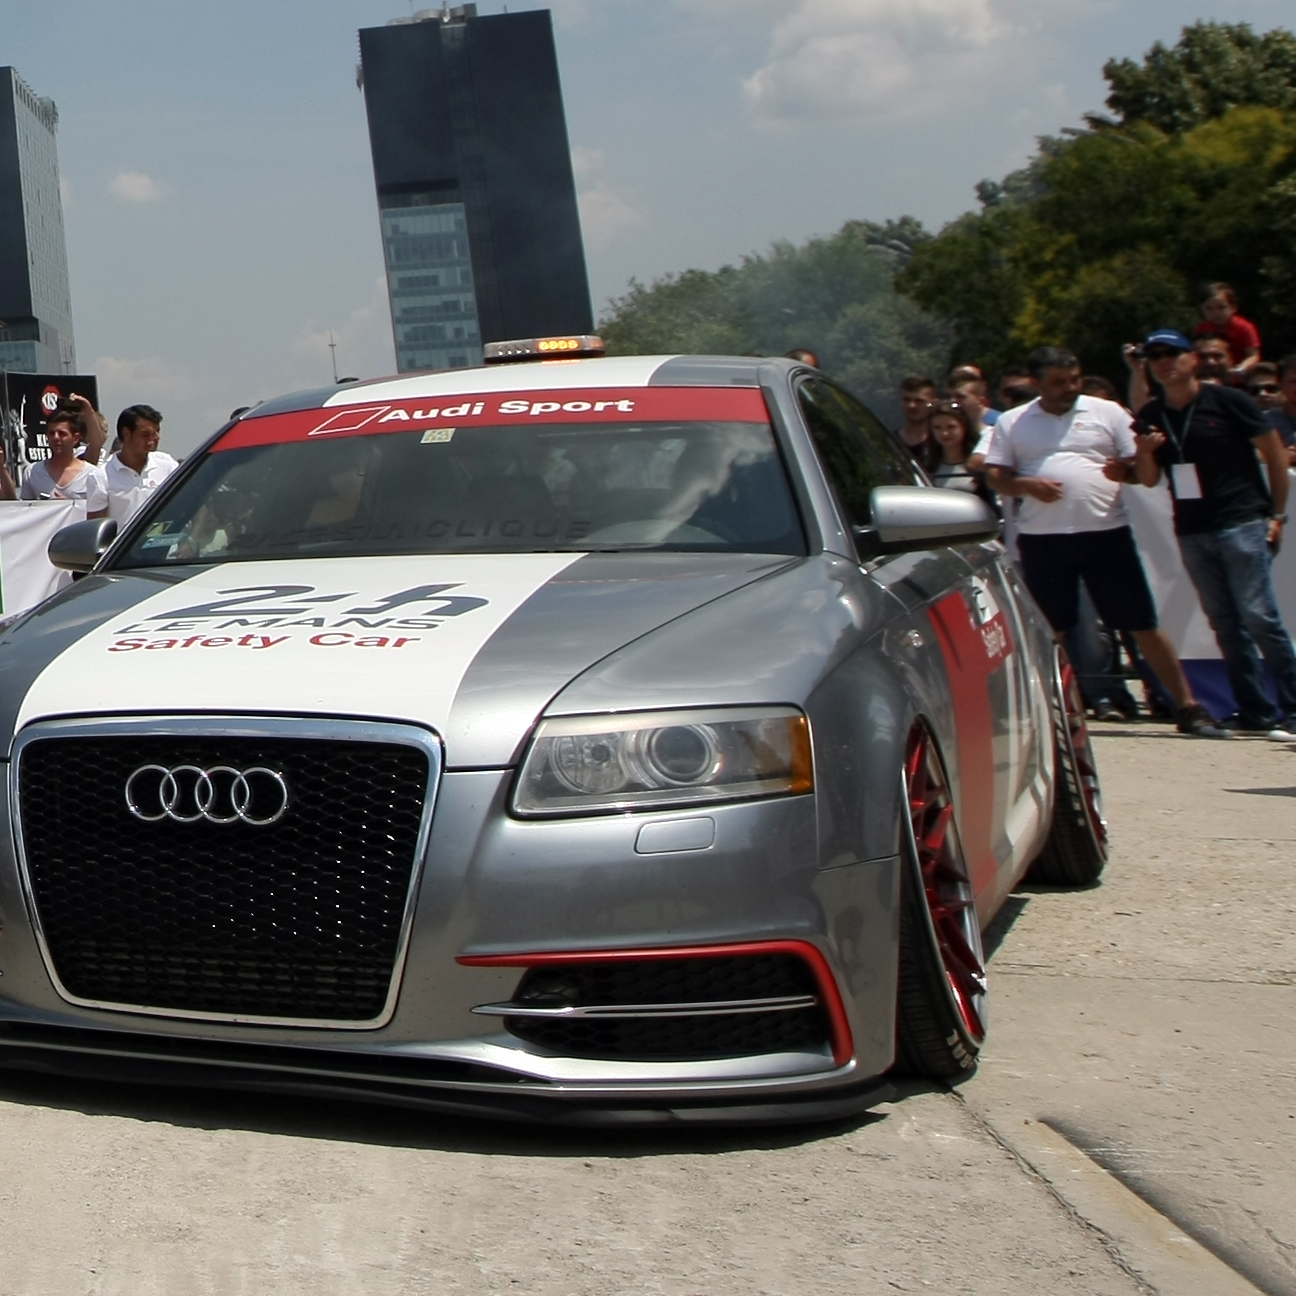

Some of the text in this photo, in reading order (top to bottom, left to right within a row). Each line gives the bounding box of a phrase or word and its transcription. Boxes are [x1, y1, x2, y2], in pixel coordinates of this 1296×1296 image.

[378, 399, 635, 423] Audi Sport
[112, 616, 446, 635] LE MANS
[107, 632, 423, 652] Safety Car
